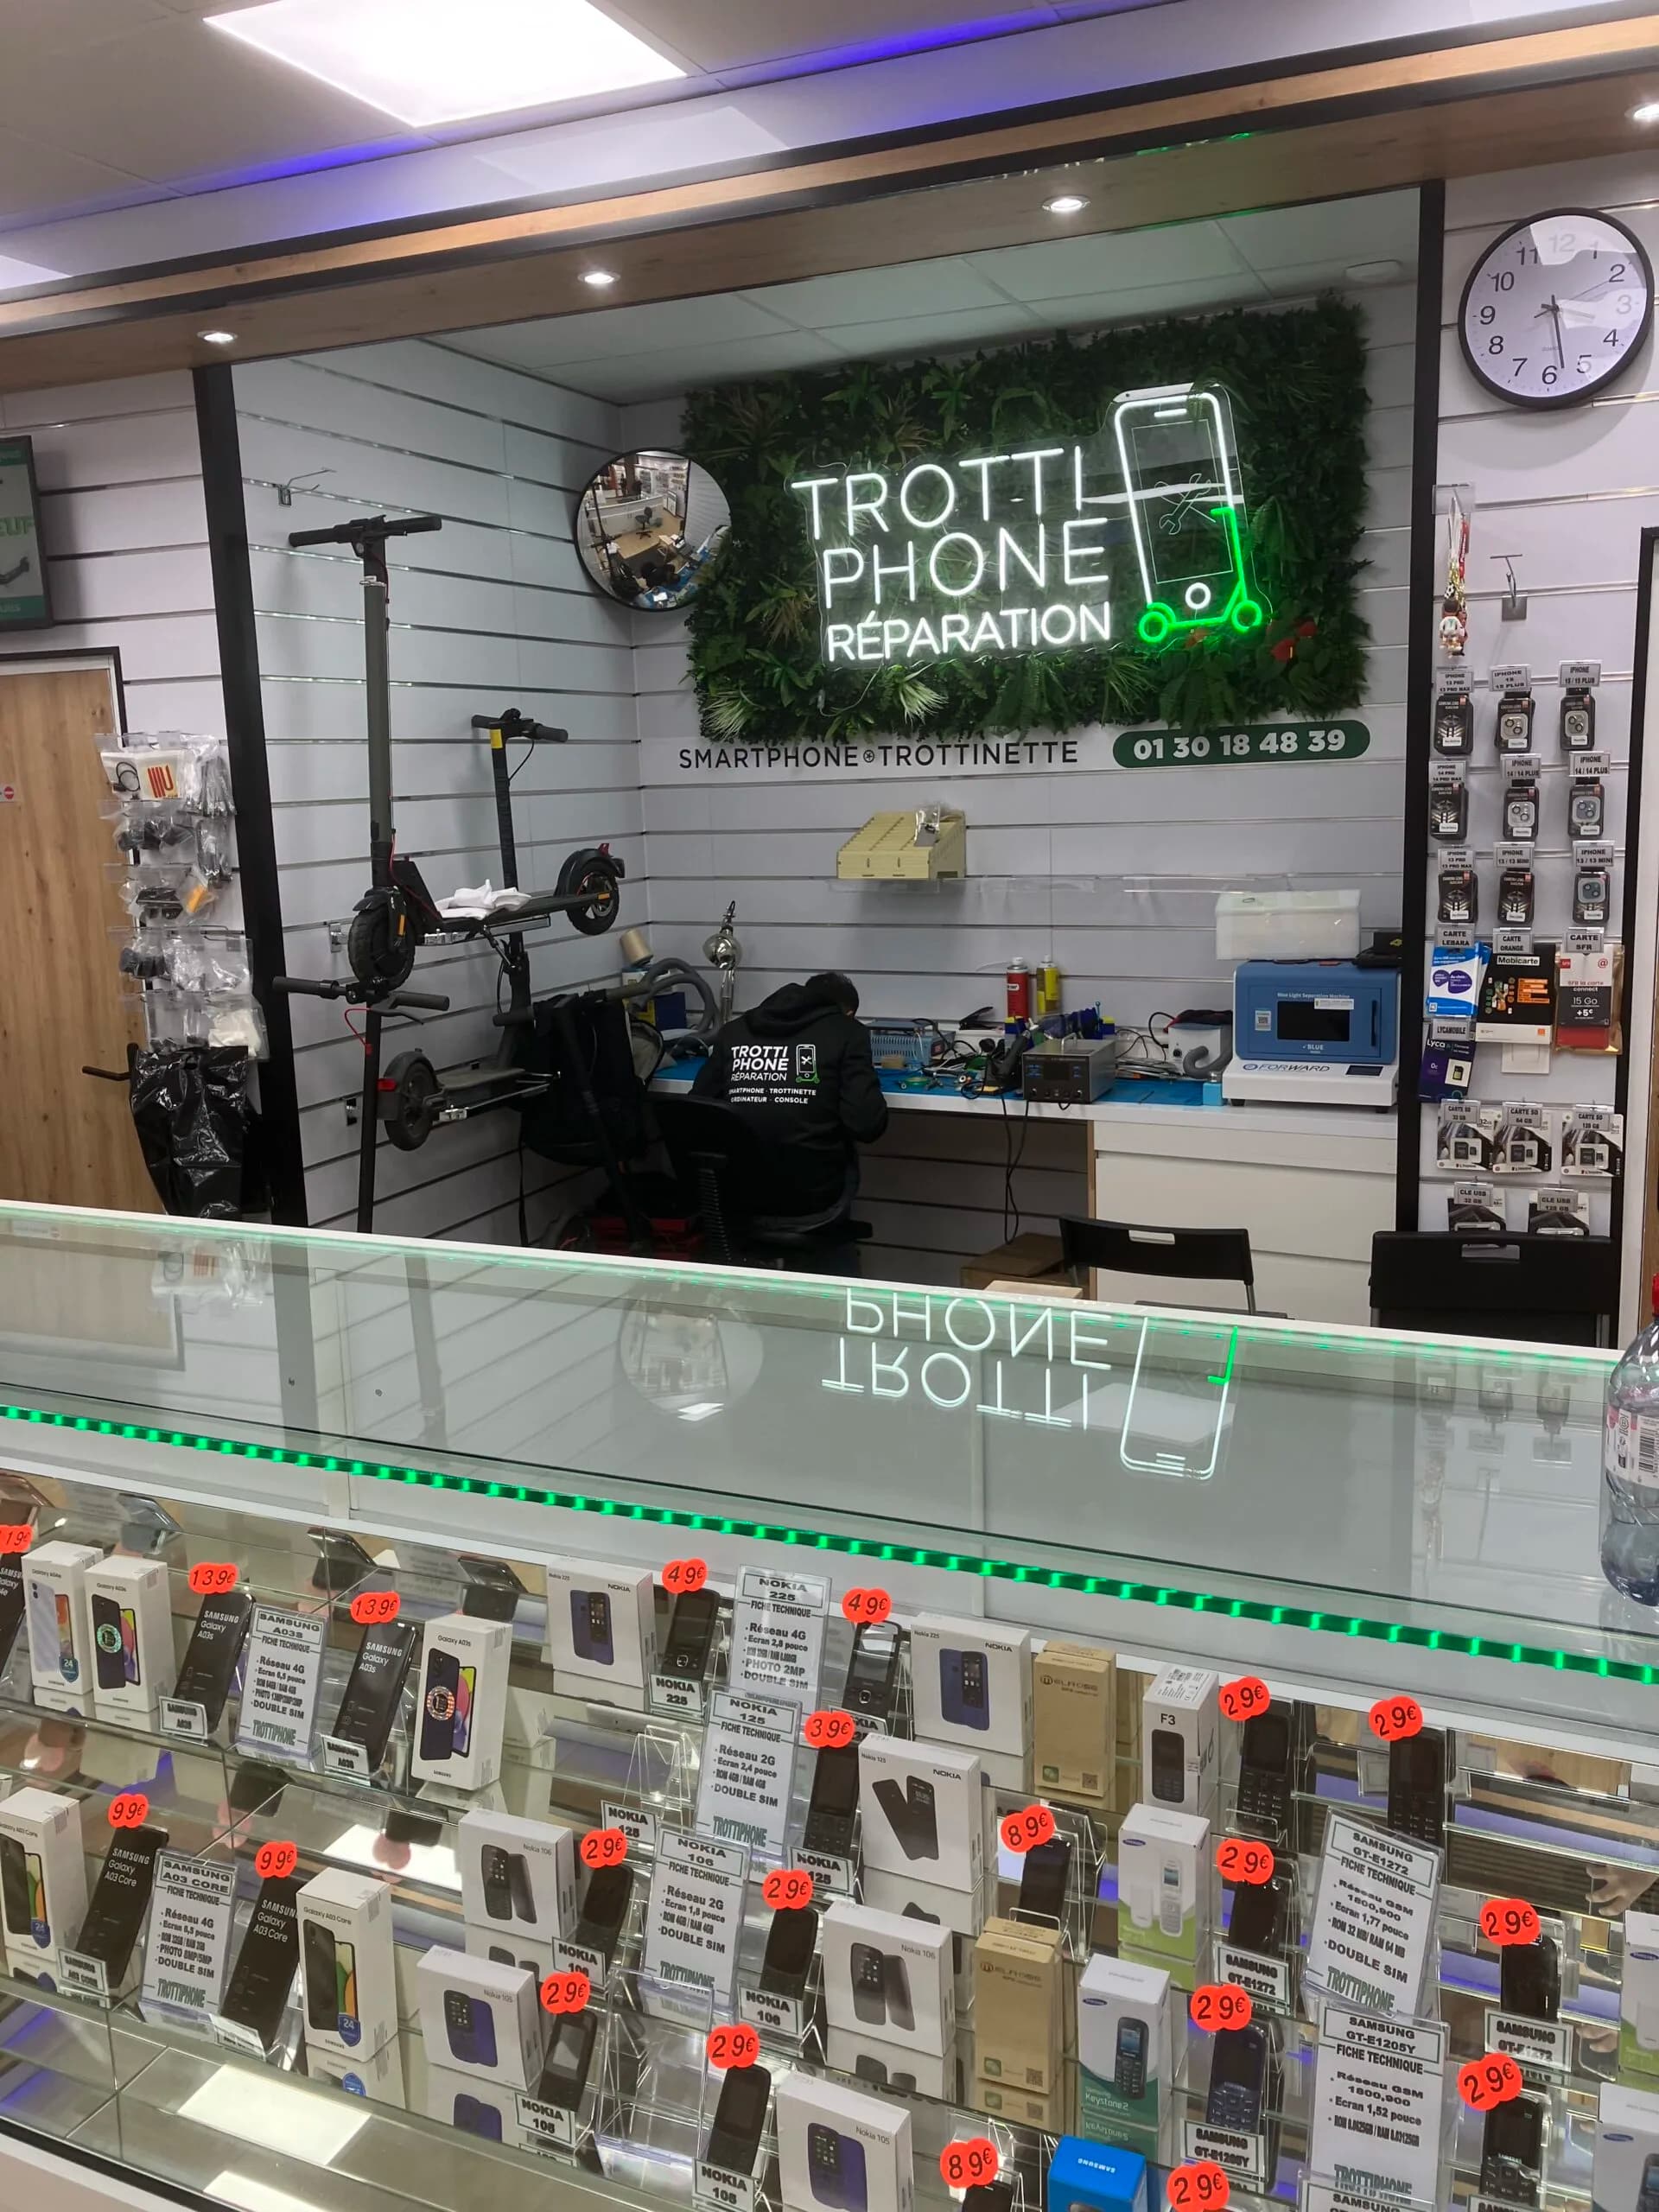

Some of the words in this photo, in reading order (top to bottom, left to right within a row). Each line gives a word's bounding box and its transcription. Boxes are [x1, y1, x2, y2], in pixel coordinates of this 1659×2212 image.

[1549, 234, 1575, 252] 12
[1516, 247, 1539, 265] 11
[1491, 271, 1514, 292] 10
[1609, 264, 1625, 283] 2
[1617, 295, 1631, 314] 3
[1479, 306, 1496, 325] 9
[1489, 336, 1503, 354] 8
[1603, 329, 1618, 346] 4
[1512, 358, 1528, 376] 7
[1577, 355, 1592, 373] 5
[1541, 365, 1557, 385] 6
[791, 445, 1083, 539] TROTTI
[823, 517, 1109, 609] PHONE
[827, 601, 1111, 663] RÉPARATION
[1133, 739, 1166, 760] 01
[1173, 736, 1209, 758] 30
[1218, 734, 1250, 756] 18
[1258, 732, 1298, 755] 48
[1306, 729, 1346, 753] 39
[678, 745, 859, 769] SMARTPHONE
[881, 741, 1078, 768] TROTTINETTE
[731, 1046, 788, 1058] TROTTI
[733, 1058, 789, 1071] PHONE
[731, 1071, 786, 1081] RÉPARATION
[192, 1570, 234, 1586] 139€
[667, 1565, 704, 1585] 49€
[759, 1578, 808, 1592] NOKIA
[608, 1583, 631, 1593] NOKIA
[768, 1591, 796, 1602] 225
[354, 1601, 397, 1617] 139€
[849, 1593, 888, 1615] 49€
[204, 1610, 239, 1624] SAMSUNG
[259, 1613, 320, 1631] SAMSUNG
[197, 1631, 213, 1641] A03s
[200, 1621, 226, 1634] Galaxy
[749, 1622, 789, 1637] Réseau
[791, 1627, 806, 1640] 4G
[365, 1642, 403, 1657] SAMSUNG
[985, 1642, 1013, 1652] NOKIA
[259, 1656, 290, 1671] Réseau
[293, 1663, 305, 1674] 4G
[359, 1663, 376, 1674] A03s
[362, 1652, 390, 1666] Galaxy
[745, 1658, 781, 1673] PHOTO
[784, 1665, 806, 1676] 2MP
[656, 1677, 696, 1694] NOKIA
[253, 1699, 284, 1714] DOUBLE
[287, 1708, 304, 1719] SIM
[666, 1694, 688, 1705] 225
[729, 1698, 778, 1716] NOKIA
[1224, 1686, 1263, 1715] 29€
[740, 1713, 766, 1725] 125
[810, 1719, 850, 1738] 39€
[1160, 1713, 1176, 1725] F3
[1375, 1706, 1416, 1736] 29€
[252, 1720, 296, 1746] TROTTIPHONE
[719, 1744, 759, 1762] Réseau
[760, 1754, 776, 1766] 2G
[933, 1769, 961, 1781] NOKIA
[714, 1783, 756, 1802] DOUBLE
[759, 1795, 778, 1808] SIM
[112, 1802, 145, 1821] 99€
[608, 1807, 649, 1825] NOKIA
[713, 1815, 767, 1847] TROTTIPHONE
[1007, 1813, 1048, 1846] 89€
[111, 1847, 149, 1866] SAMSUNG
[586, 1838, 623, 1859] 29€
[677, 1839, 727, 1858] NOKIA
[1353, 1833, 1414, 1862] SAMSUNG
[107, 1859, 135, 1875] Galaxy
[260, 1849, 294, 1870] 99€
[689, 1854, 714, 1867] 106
[797, 1853, 842, 1872] NOKIA
[1221, 1846, 1269, 1874] 29€
[1353, 1847, 1409, 1875] GT-E1272
[163, 1859, 231, 1882] SAMSUNG
[1341, 1856, 1365, 1875] FICHE
[1367, 1866, 1415, 1896] TECHNIQUE
[162, 1872, 188, 1885] A03
[192, 1879, 229, 1893] CORE
[767, 1878, 809, 1899] 29€
[667, 1885, 707, 1904] Réseau
[709, 1897, 724, 1910] 2G
[164, 1909, 200, 1923] Réseau
[201, 1917, 213, 1929] 4G
[257, 1911, 287, 1929] Galaxy
[1485, 1910, 1533, 1936] 29€
[660, 1925, 703, 1945] DOUBLE
[706, 1940, 725, 1954] SIM
[558, 1944, 598, 1965] NOKIA
[1327, 1939, 1380, 1971] DOUBLE
[1383, 1965, 1408, 1984] SIM
[158, 1956, 195, 1974] DOUBLE
[198, 1967, 214, 1978] SIM
[1225, 1955, 1278, 1979] SAMSUNG
[157, 1979, 206, 2008] TROTTIPHONE
[546, 1981, 587, 2005] 29€
[1326, 1966, 1395, 2012] TROTTIPHONE
[746, 1991, 791, 2012] NOKIA
[1197, 1994, 1245, 2019] 29€
[1349, 2017, 1415, 2039] SAMSUNG
[1497, 2020, 1556, 2044] SAMSUNG
[712, 2035, 755, 2057] 29€
[1346, 2031, 1416, 2054] GT-E1205Y
[1337, 2044, 1366, 2061] FICHE
[1367, 2054, 1423, 2075] TECHNIQUE
[1337, 2071, 1388, 2090] Réseau
[1391, 2086, 1423, 2099] GSM
[1464, 2063, 1515, 2103] 29€
[521, 2099, 564, 2121] NOKIA
[1335, 2096, 1364, 2112] Ecran
[1367, 2103, 1388, 2118] 1,52
[1390, 2111, 1421, 2126] pouce
[533, 2118, 556, 2133] 105
[855, 2126, 875, 2140] Nokia
[876, 2133, 890, 2145] 105
[1196, 2127, 1248, 2152] SAMSUNG
[948, 2146, 993, 2182] 89€
[702, 2165, 747, 2191] NOKIA
[1173, 2172, 1223, 2205] 29€
